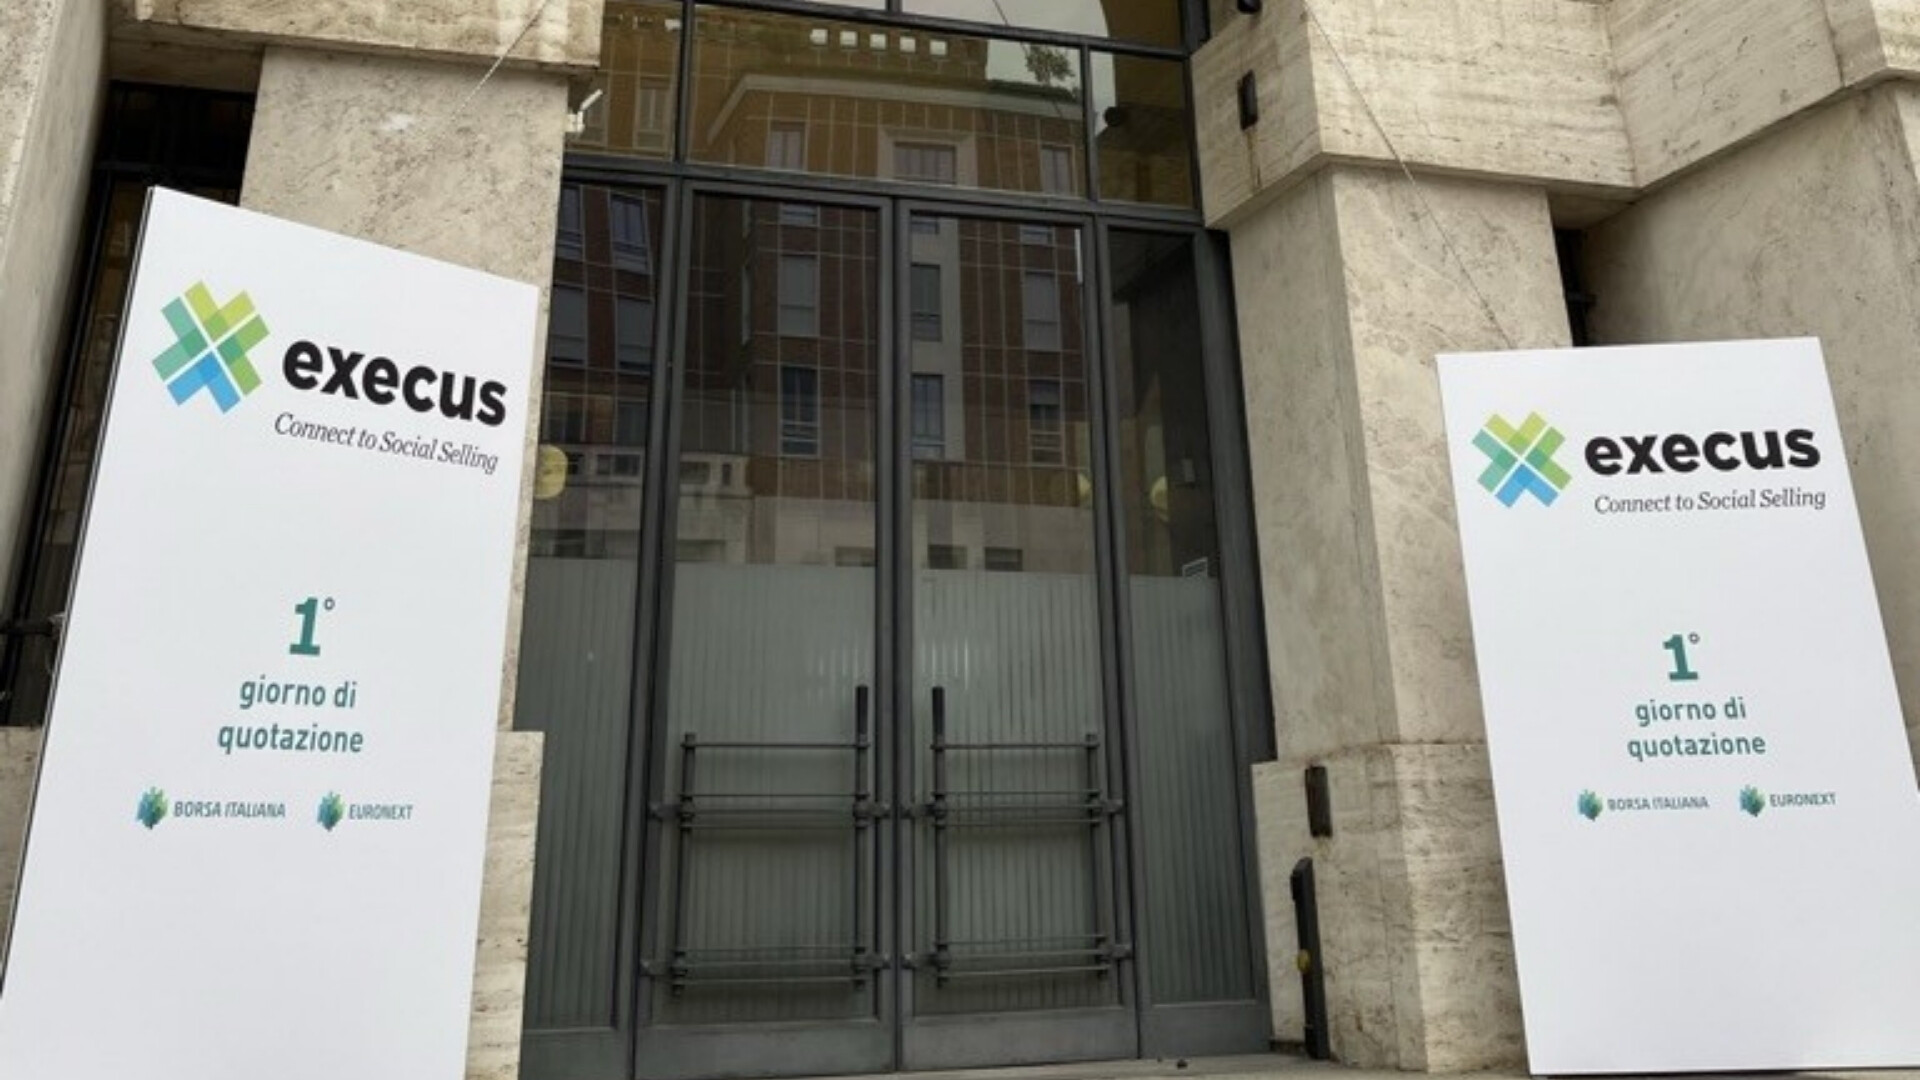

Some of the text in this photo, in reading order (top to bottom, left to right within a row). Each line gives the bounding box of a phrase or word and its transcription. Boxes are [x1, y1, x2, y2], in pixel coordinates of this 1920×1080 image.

[283, 340, 507, 426] execus
[275, 412, 498, 475] Connect to Social Selling
[1585, 429, 1820, 475] execus
[1594, 487, 1826, 514] Connect to Social Selling
[240, 675, 357, 710] giorno di
[1635, 696, 1746, 727] giorno di
[218, 724, 363, 755] quotazione
[1627, 733, 1766, 762] quotazione
[174, 801, 285, 818] BORSA ITALIANA
[348, 804, 413, 820] EURONEXT
[1607, 796, 1710, 811] BORSA ITALIANA
[1769, 792, 1835, 808] EURONEXT
